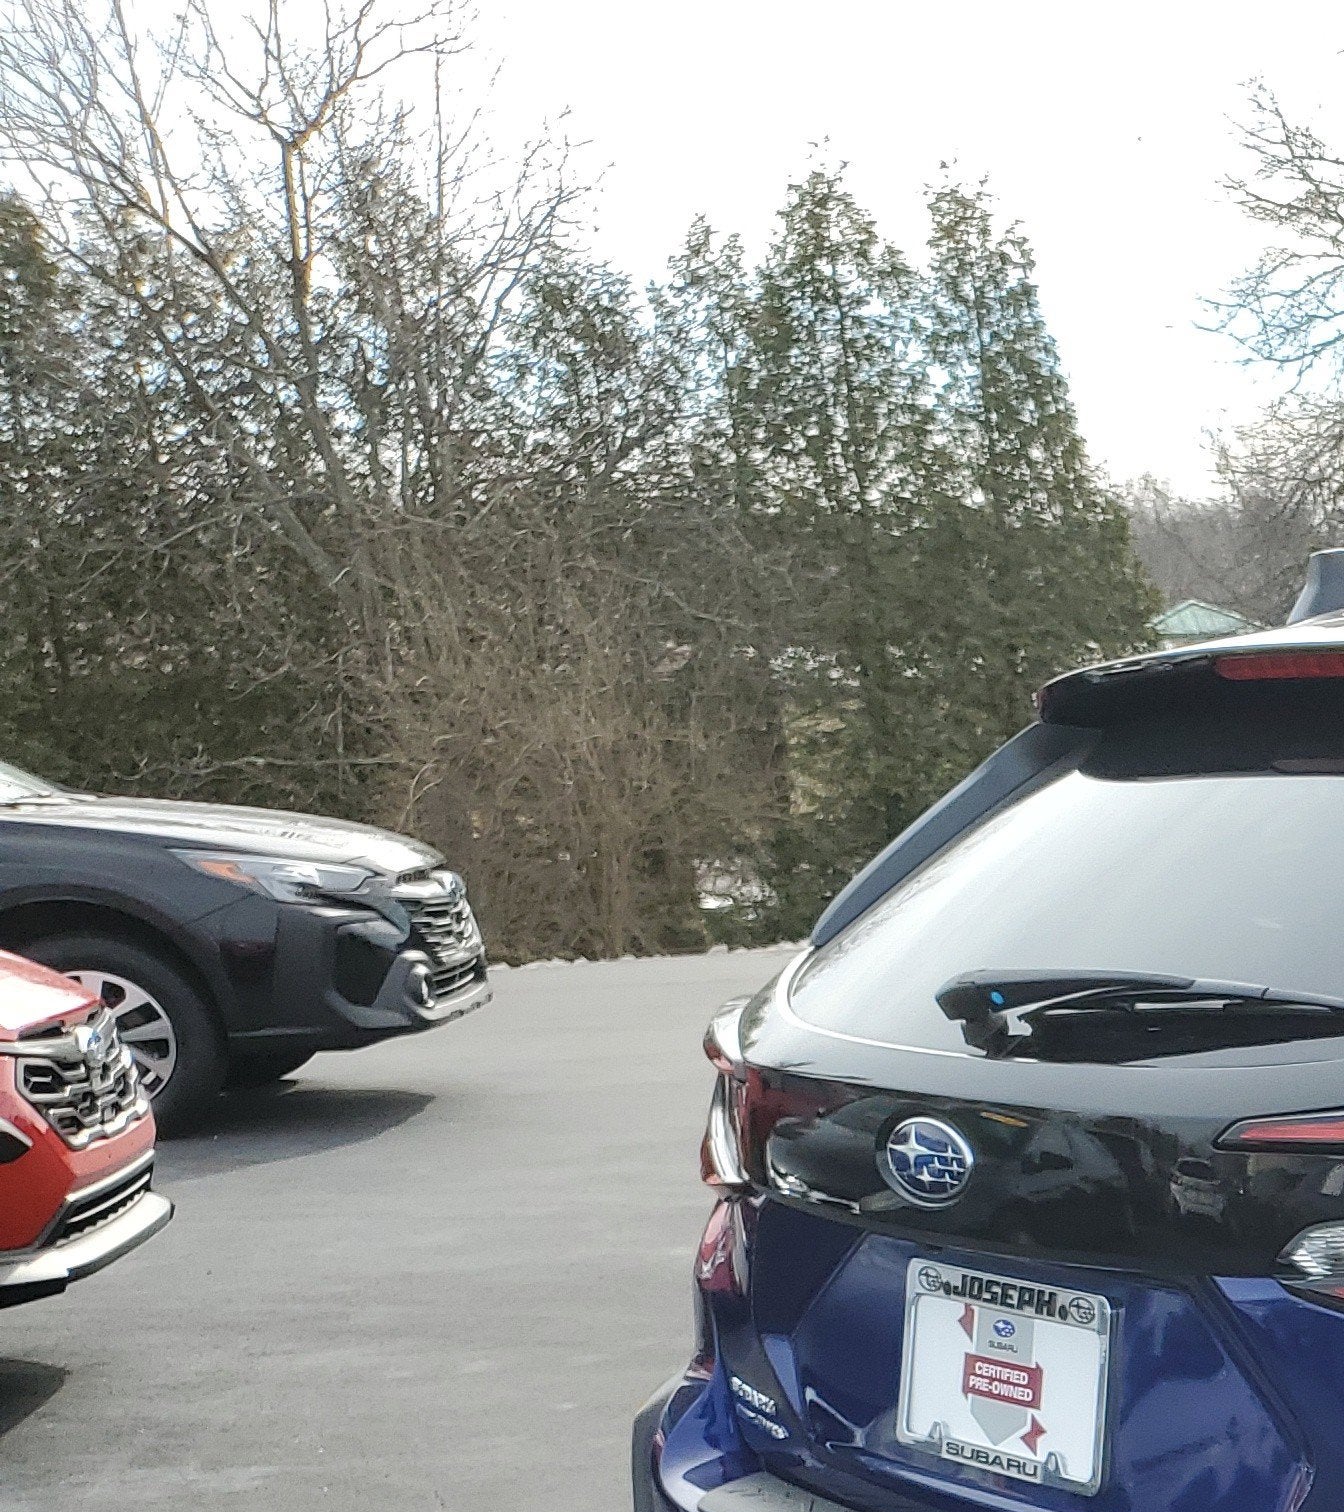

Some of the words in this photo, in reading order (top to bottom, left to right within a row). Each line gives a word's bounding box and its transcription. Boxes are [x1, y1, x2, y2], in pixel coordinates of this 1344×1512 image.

[952, 1273, 1058, 1319] JOSEPH
[968, 1375, 1033, 1402] PRE-OWNED
[974, 1361, 1029, 1385] CERTIFIED
[945, 1441, 1039, 1477] SUBARU
